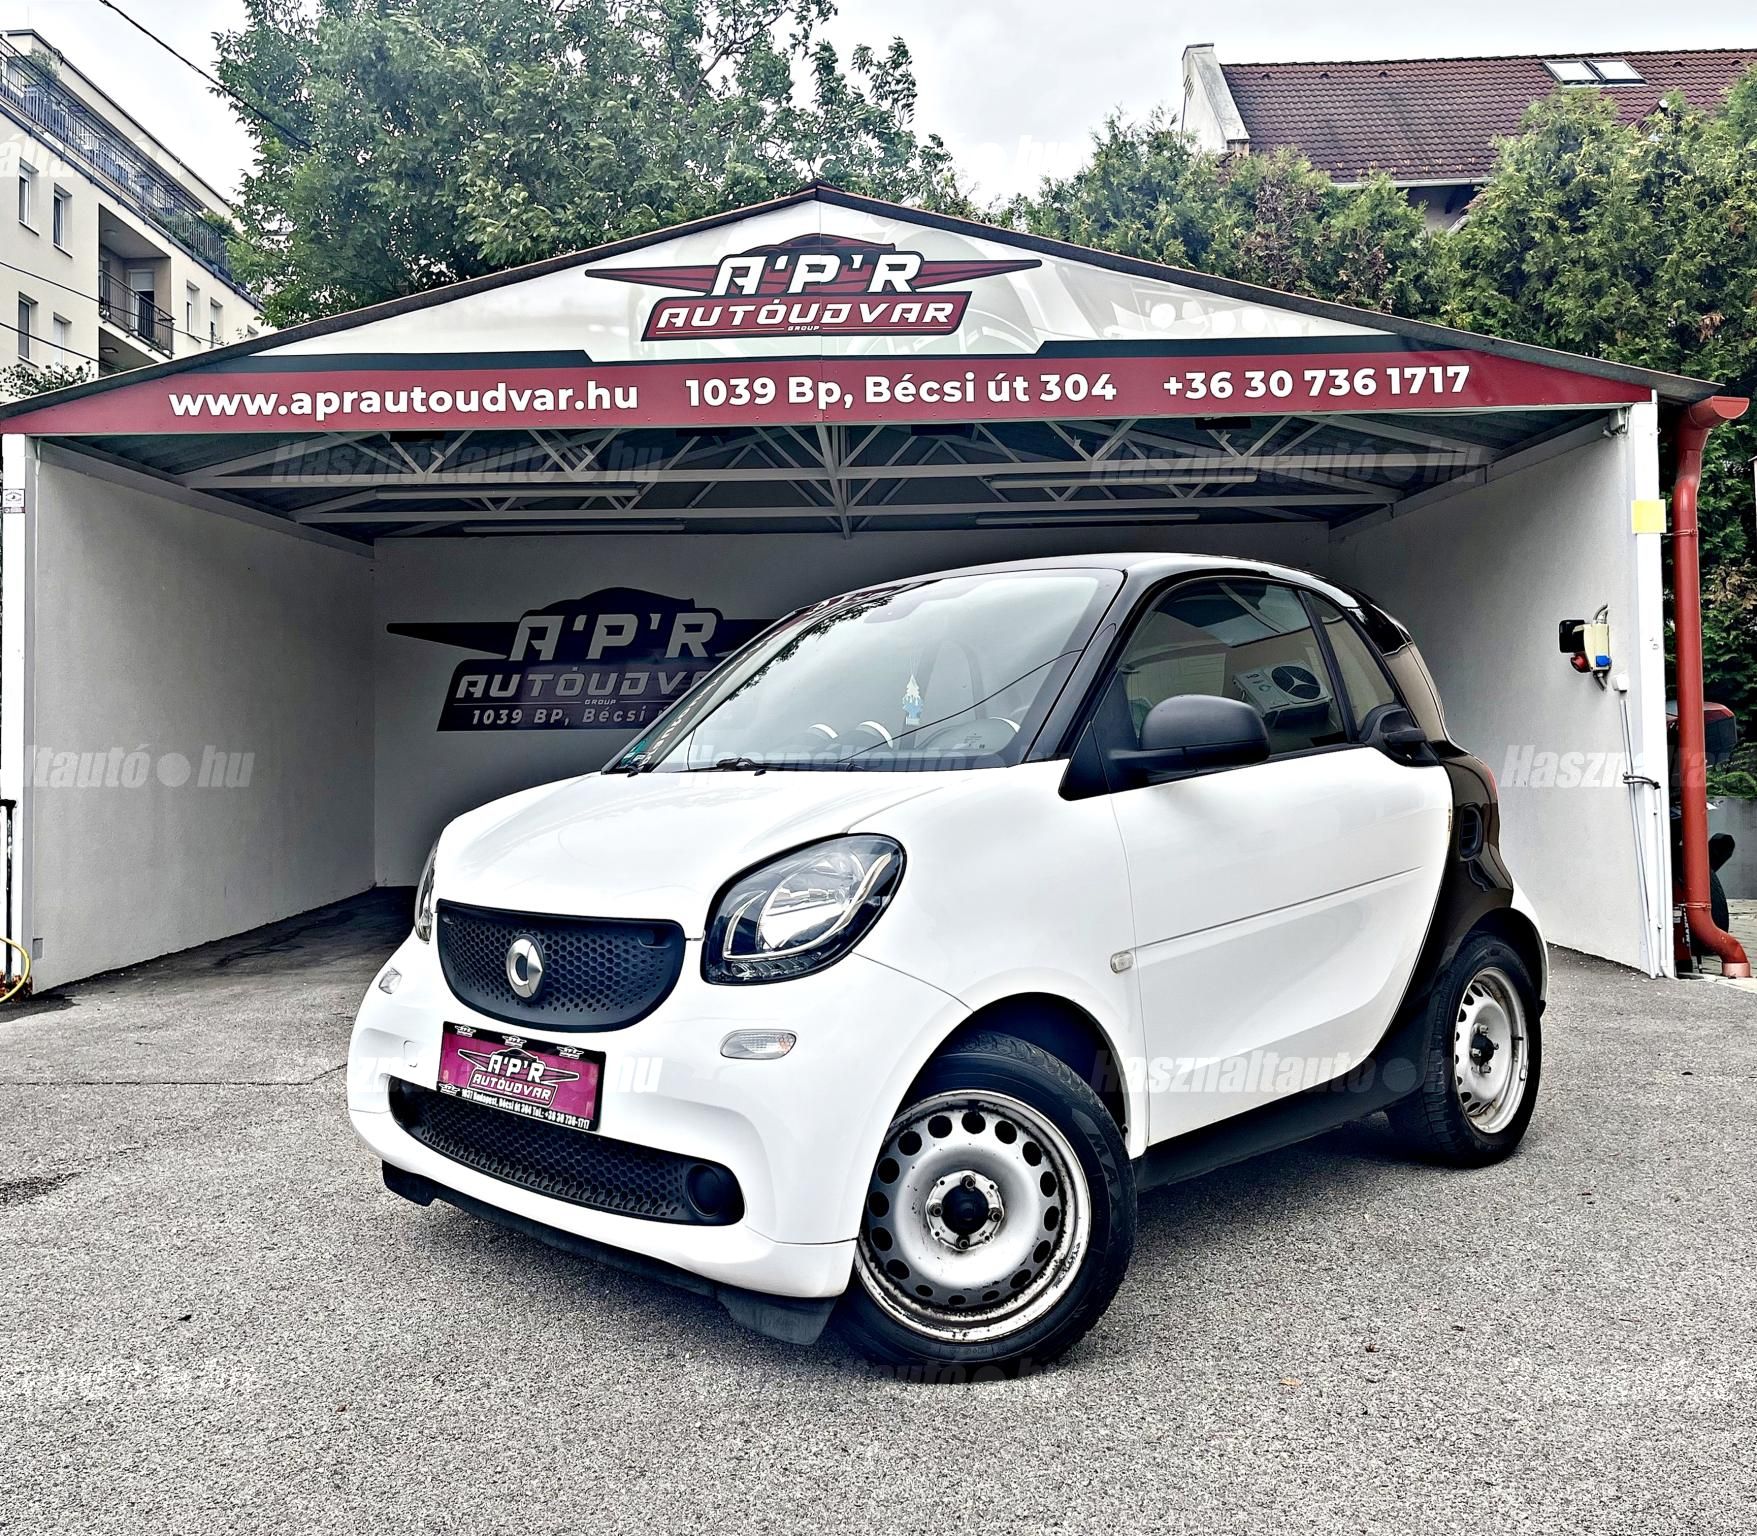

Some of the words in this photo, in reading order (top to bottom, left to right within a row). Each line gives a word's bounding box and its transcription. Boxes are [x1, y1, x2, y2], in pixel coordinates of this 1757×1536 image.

[656, 299, 954, 328] AUTÓUDVAR
[685, 377, 777, 407] 1039
[788, 376, 854, 409] Bp,
[865, 372, 976, 403] Bécsi
[987, 373, 1030, 403] út
[1040, 373, 1117, 402] 304
[1163, 371, 1233, 400] +36
[1244, 370, 1294, 398] 30
[1303, 368, 1377, 397] 736
[1386, 365, 1470, 394] 1717
[168, 380, 639, 421] www.aprautoudvar.hu
[455, 667, 710, 699] AUTÓUDV
[471, 709, 523, 725] 1039
[533, 708, 570, 727] BP,
[582, 704, 646, 724] Bécsi
[472, 1073, 552, 1101] AUTÓUDVAR
